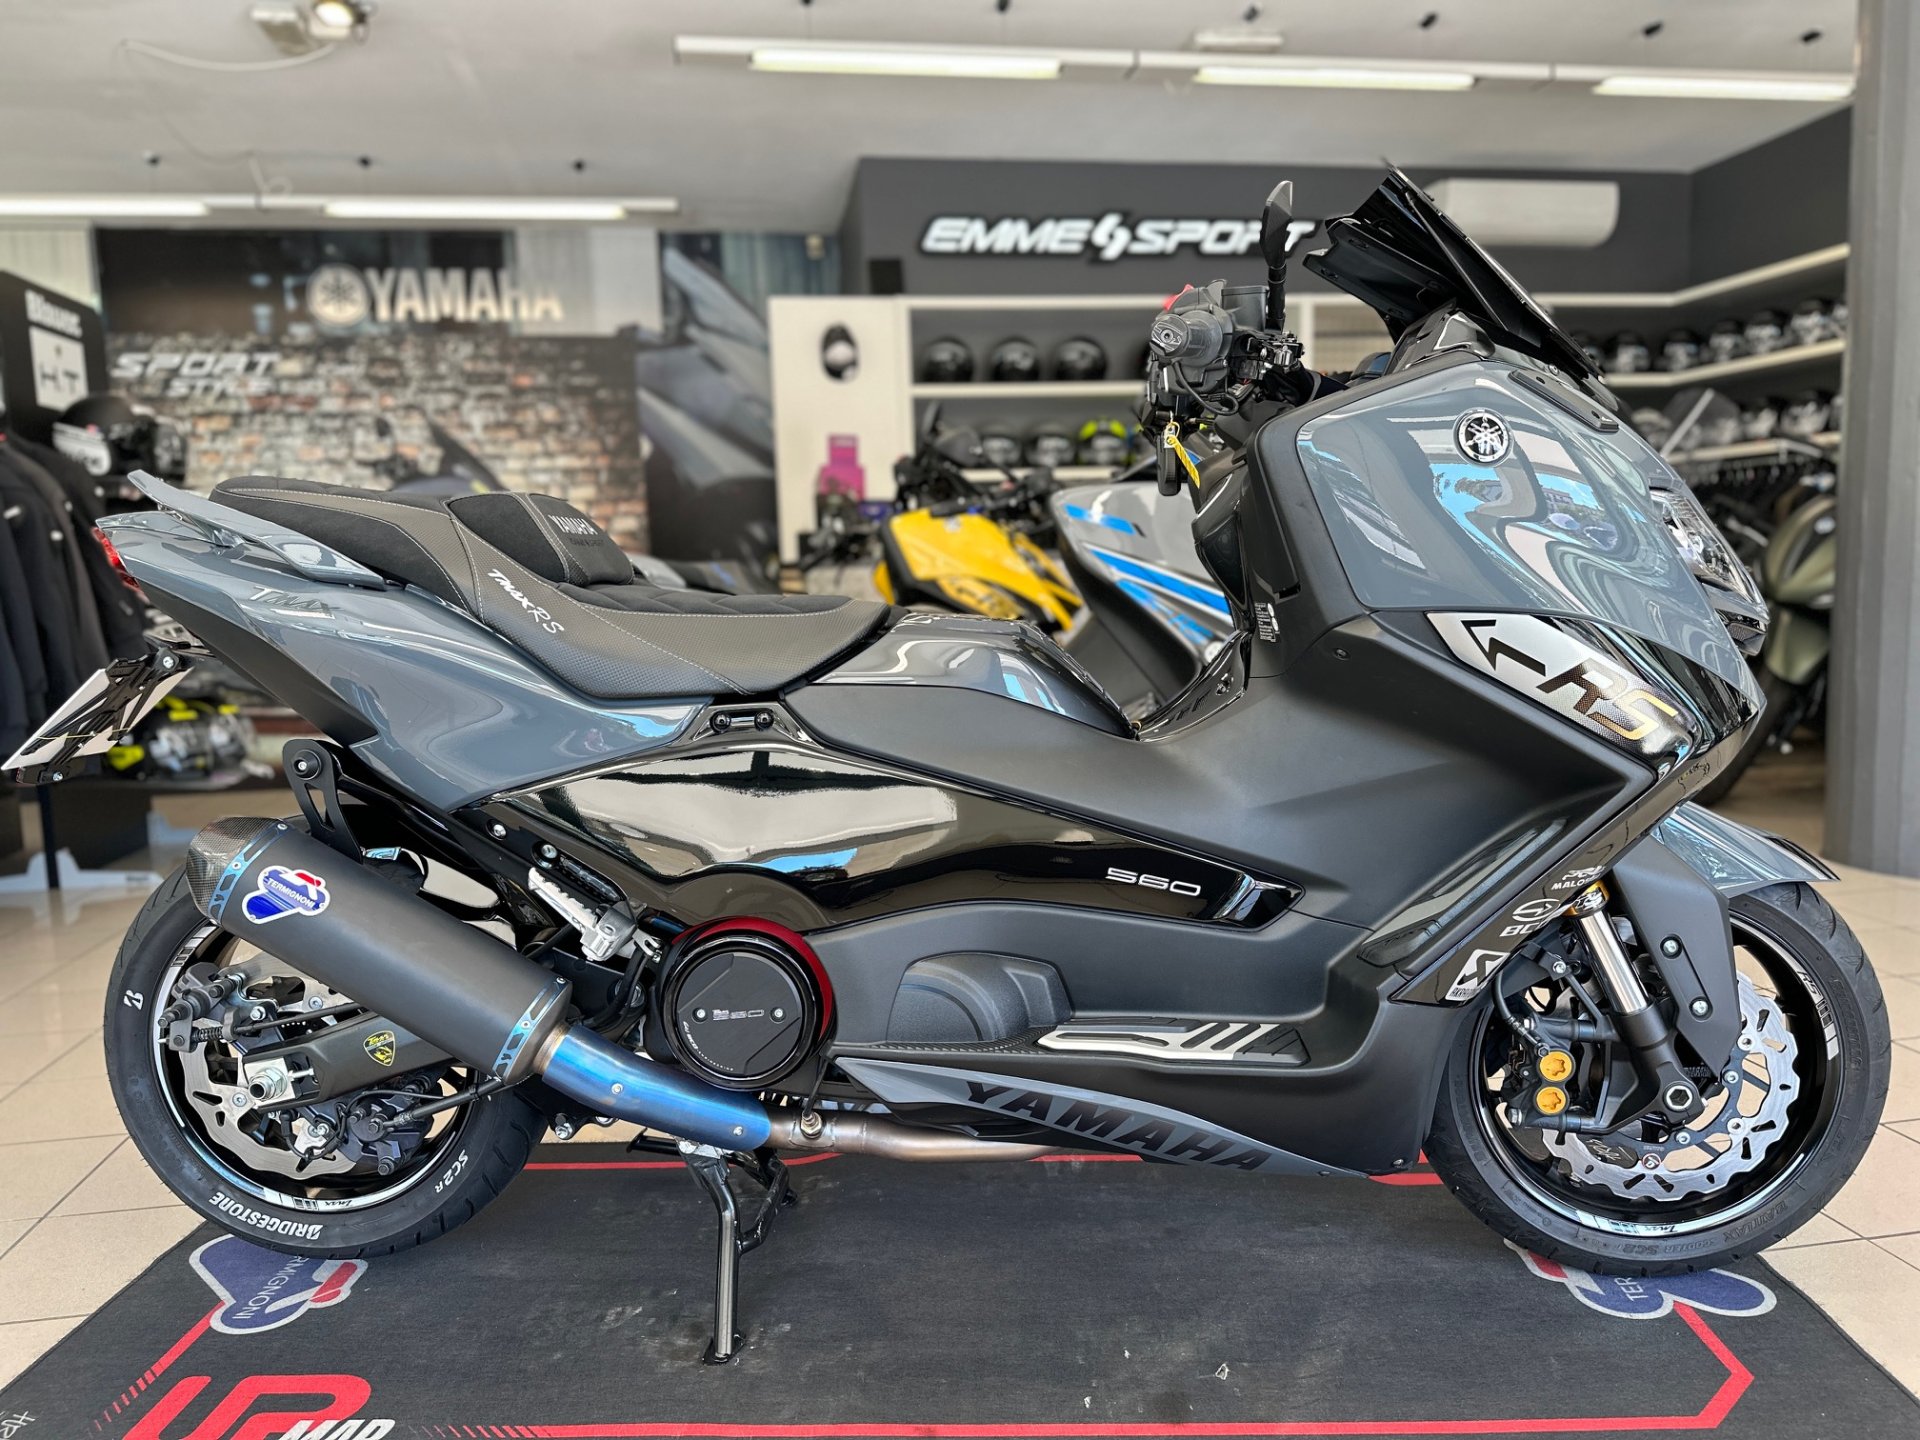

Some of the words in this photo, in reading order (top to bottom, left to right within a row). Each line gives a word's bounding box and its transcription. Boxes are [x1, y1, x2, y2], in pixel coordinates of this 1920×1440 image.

[921, 216, 1095, 253] EMME
[365, 267, 564, 322] YAMAHA
[110, 352, 282, 379] SPORT
[547, 514, 598, 535] YAMAHA
[1536, 658, 1679, 740] RS
[268, 877, 316, 909] TERMIGNONI
[1105, 867, 1201, 896] 560
[966, 1080, 1272, 1172] YAMAHA
[208, 1191, 323, 1240] BRIDGESTONE
